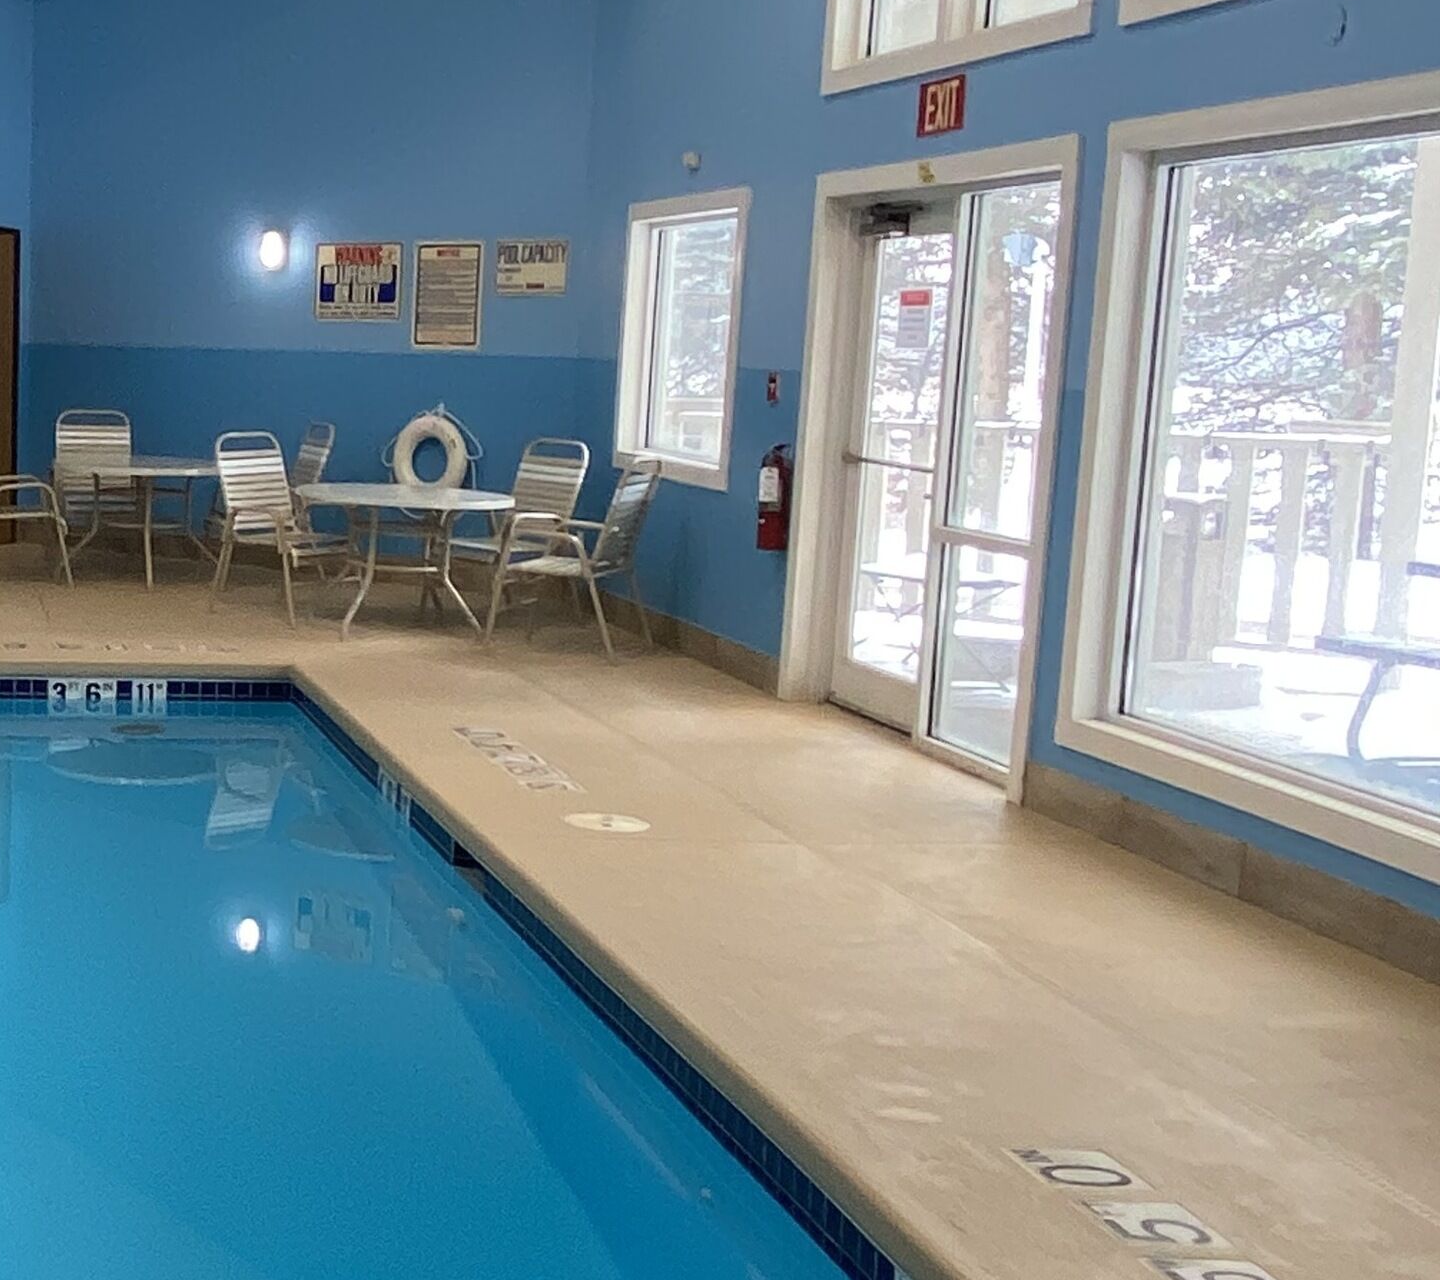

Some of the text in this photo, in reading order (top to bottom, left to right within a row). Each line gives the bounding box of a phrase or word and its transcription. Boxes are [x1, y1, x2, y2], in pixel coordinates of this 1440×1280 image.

[924, 79, 960, 133] EXIT
[497, 243, 565, 264] POOL CAPACITY
